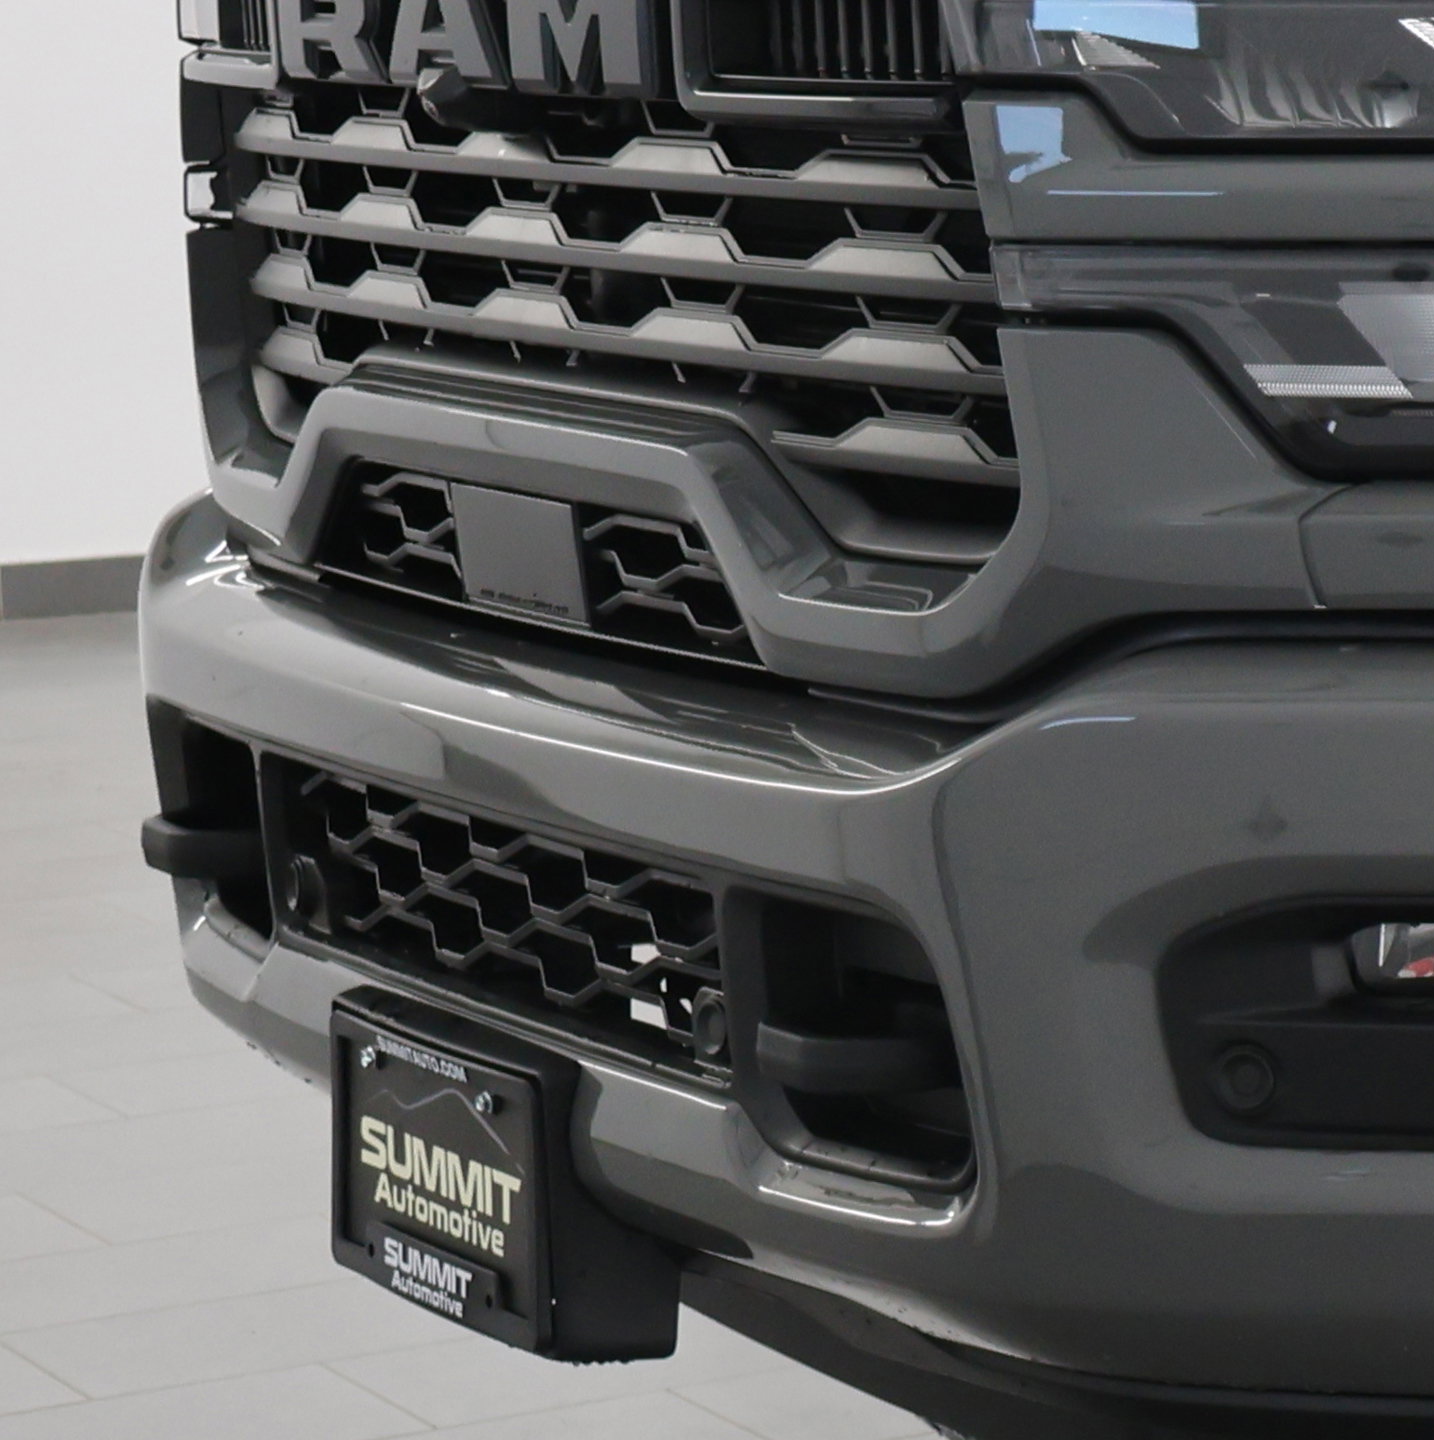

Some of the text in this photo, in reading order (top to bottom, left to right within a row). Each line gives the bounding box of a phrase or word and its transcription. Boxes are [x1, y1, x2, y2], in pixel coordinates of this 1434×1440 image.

[376, 1035, 467, 1083] SUMMITAUTO.COM
[361, 1115, 521, 1224] SUMMIT
[374, 1172, 505, 1257] Automotive
[384, 1237, 473, 1299] SUMMIT
[391, 1269, 464, 1318] Automotive
